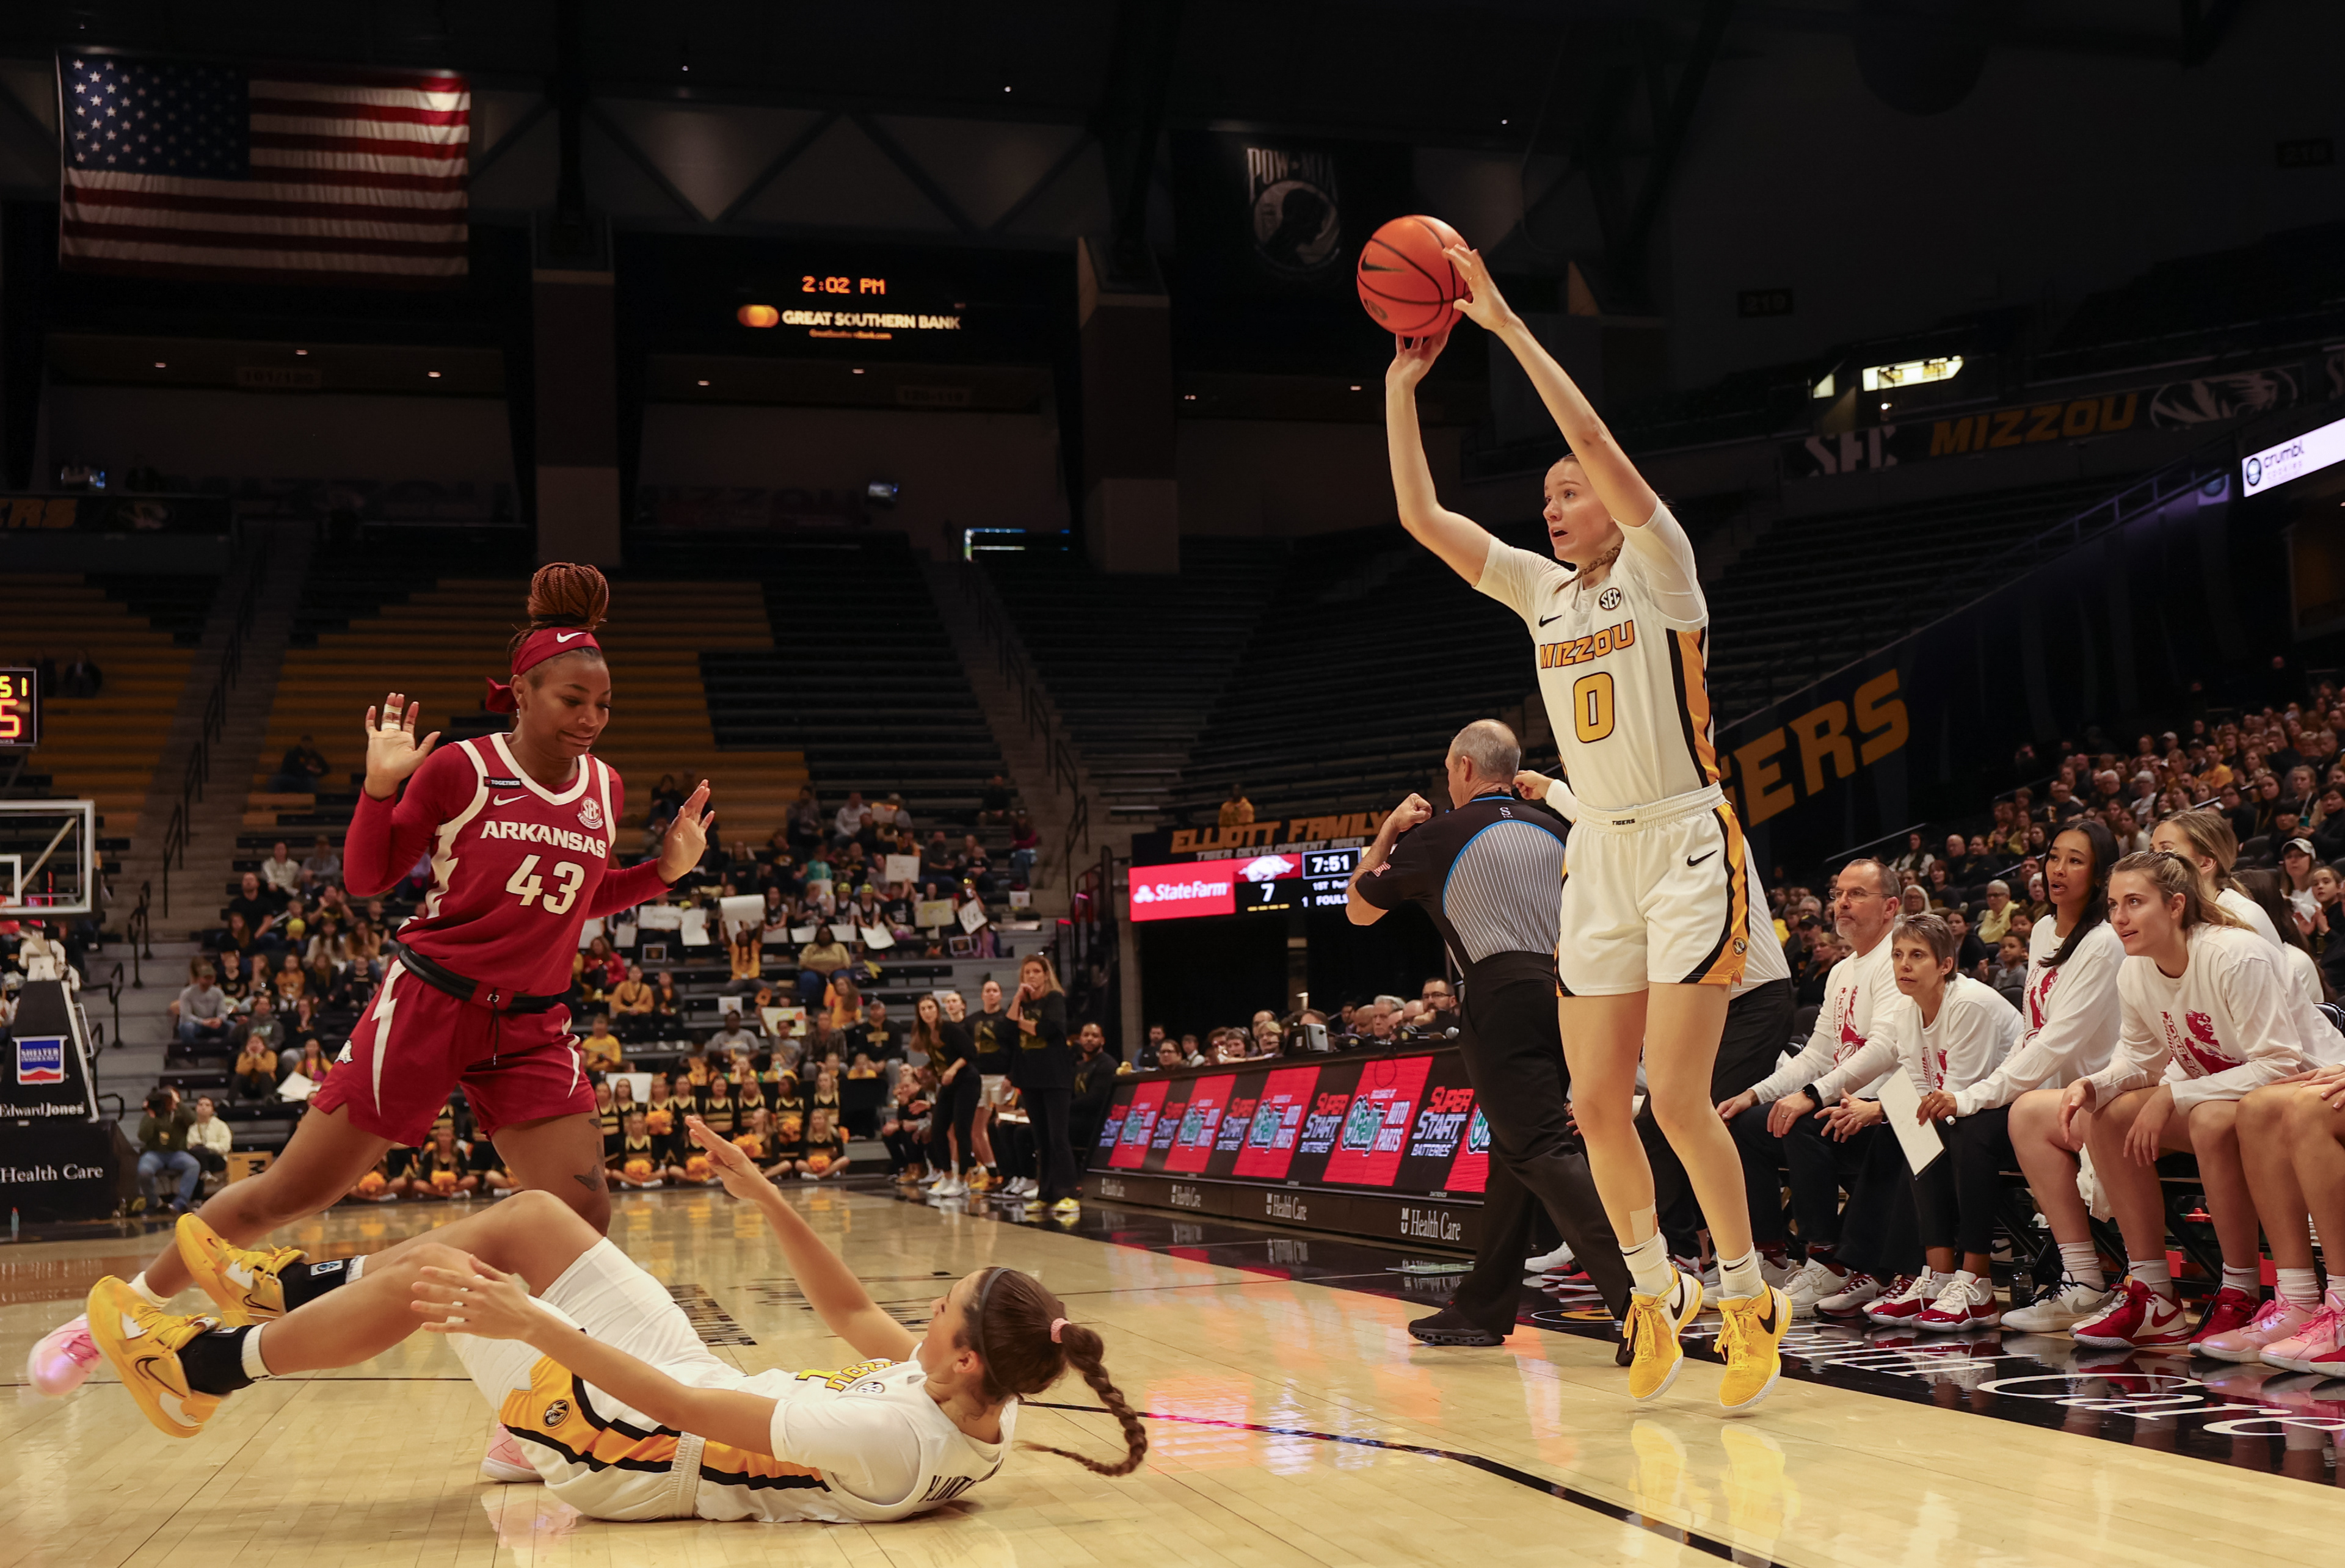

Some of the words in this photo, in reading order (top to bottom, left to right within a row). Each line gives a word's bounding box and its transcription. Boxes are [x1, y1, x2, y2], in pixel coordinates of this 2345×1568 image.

[802, 275, 851, 294] 2:02
[860, 278, 885, 295] PM
[782, 310, 833, 326] GREAT
[834, 312, 916, 328] SOUTHERN
[918, 314, 961, 330] BANK
[1930, 393, 2138, 457] MIZZOU
[1601, 588, 1621, 609] SEC
[1540, 619, 1635, 669] MIZZOU
[1573, 672, 1615, 744] 0
[583, 799, 599, 820] SEC
[479, 821, 606, 858] ARKANSAS
[1170, 821, 1282, 854] ELLIOTT
[1287, 810, 1393, 843] FAMILY
[1312, 855, 1350, 873] 7:51
[506, 854, 585, 915] 43
[1261, 883, 1274, 902] 7
[1312, 881, 1329, 891] 1ST
[1301, 896, 1309, 908] 1
[1315, 894, 1349, 906] FOULS
[2167, 1015, 2189, 1056] BACK
[1313, 1093, 1349, 1115] SUPER
[1425, 1086, 1474, 1112] SUPER
[1301, 1114, 1343, 1138] START
[1412, 1110, 1467, 1139] START
[1411, 1144, 1452, 1156] BATTERIES
[1, 1164, 58, 1183] Health
[63, 1163, 103, 1180] Care
[1273, 1194, 1292, 1218] Health
[1410, 1210, 1438, 1238] Health
[1440, 1212, 1461, 1241] Care
[1977, 1373, 2345, 1436] Care
